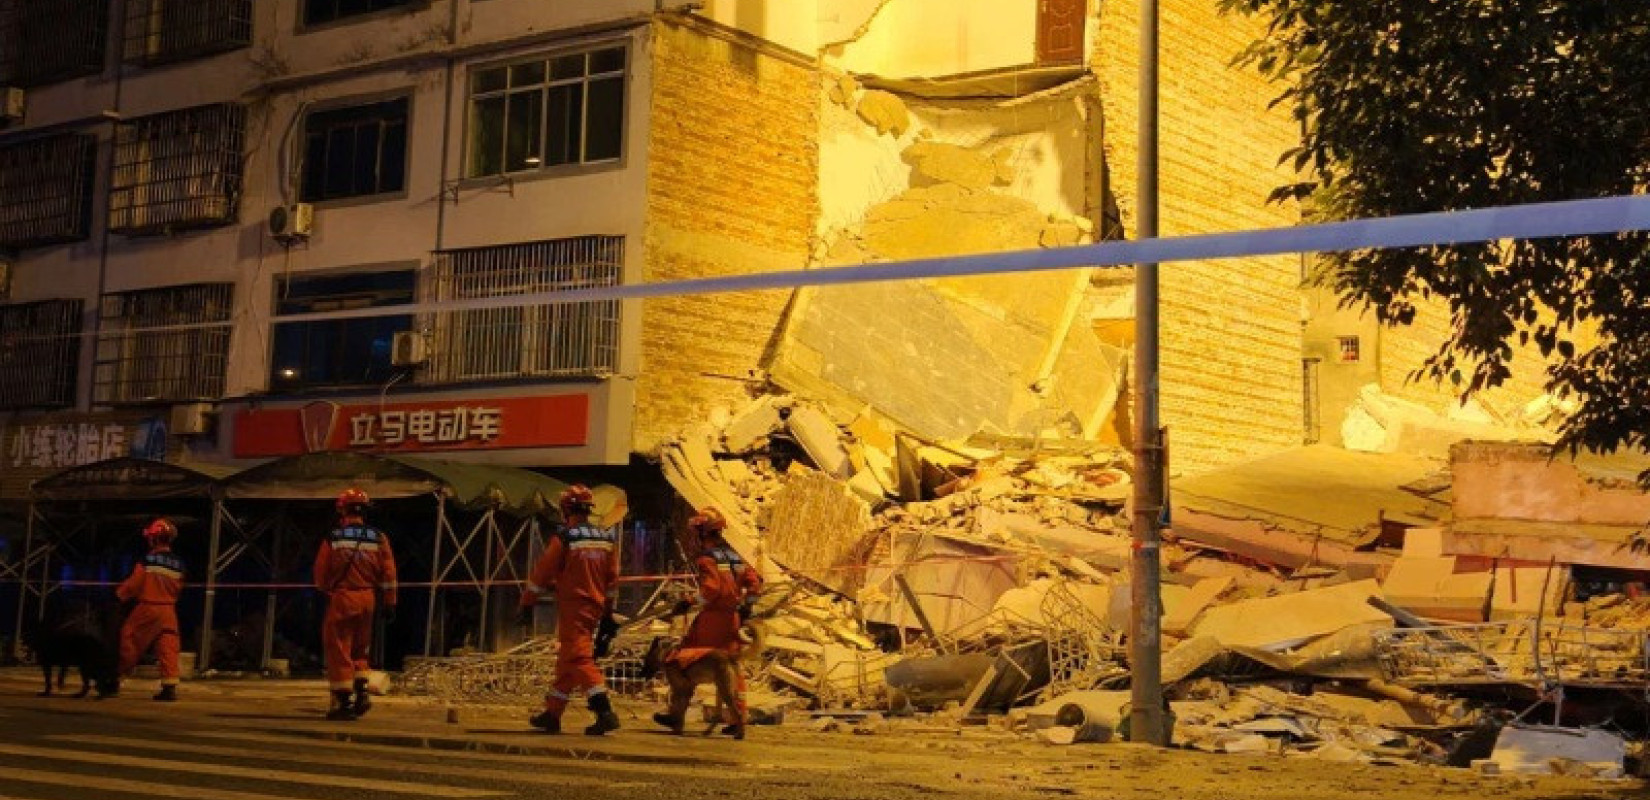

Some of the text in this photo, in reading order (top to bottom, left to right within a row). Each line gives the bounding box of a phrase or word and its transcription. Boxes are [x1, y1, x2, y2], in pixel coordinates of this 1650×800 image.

[350, 406, 502, 446] 立马电动车
